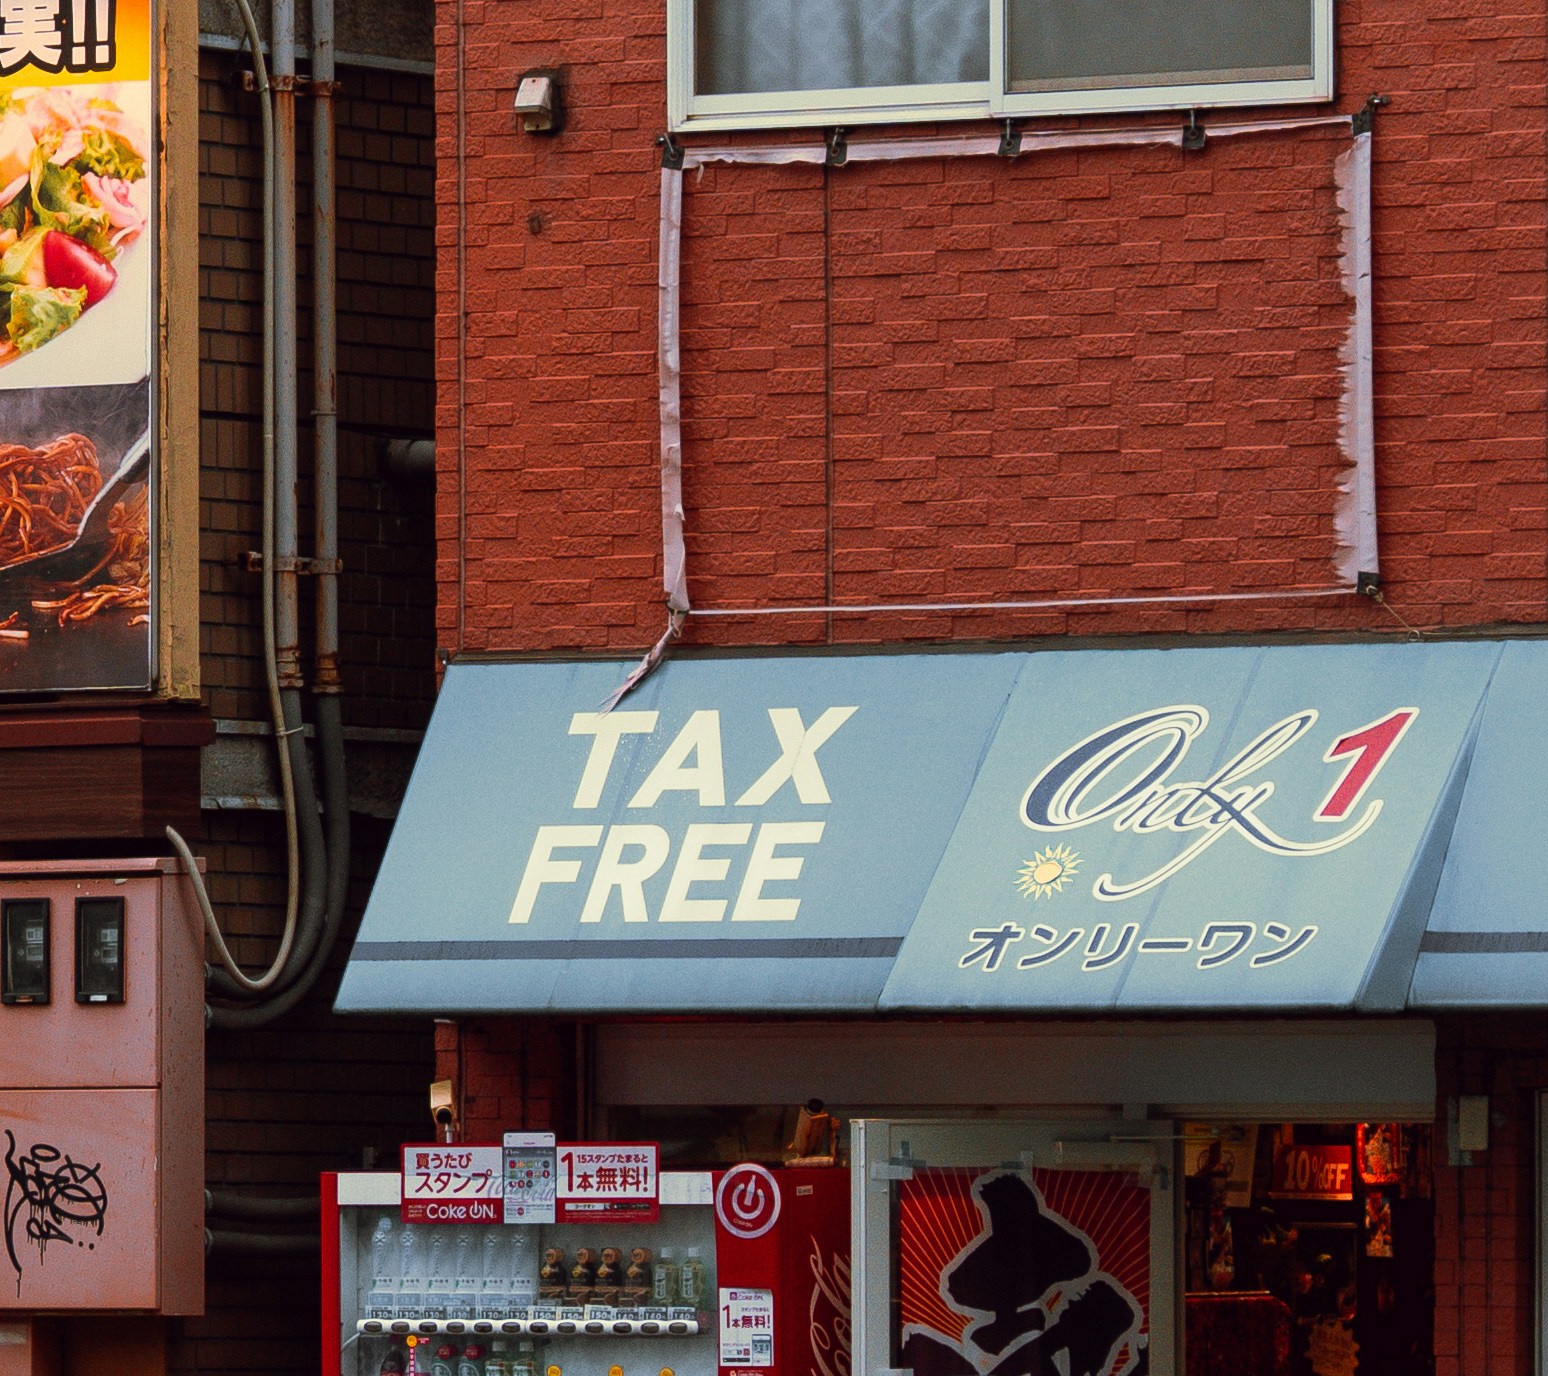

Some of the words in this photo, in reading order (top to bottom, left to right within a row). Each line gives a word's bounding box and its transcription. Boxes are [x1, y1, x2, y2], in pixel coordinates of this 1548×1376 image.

[568, 706, 860, 809] TAX
[508, 821, 826, 924] FREE
[959, 921, 1318, 972] オンリーワン
[416, 1153, 472, 1169] 買うたび
[560, 1152, 574, 1192] 1
[415, 1169, 492, 1193] スタンプ
[576, 1167, 649, 1192] 本無料!
[426, 1204, 466, 1219] Coke
